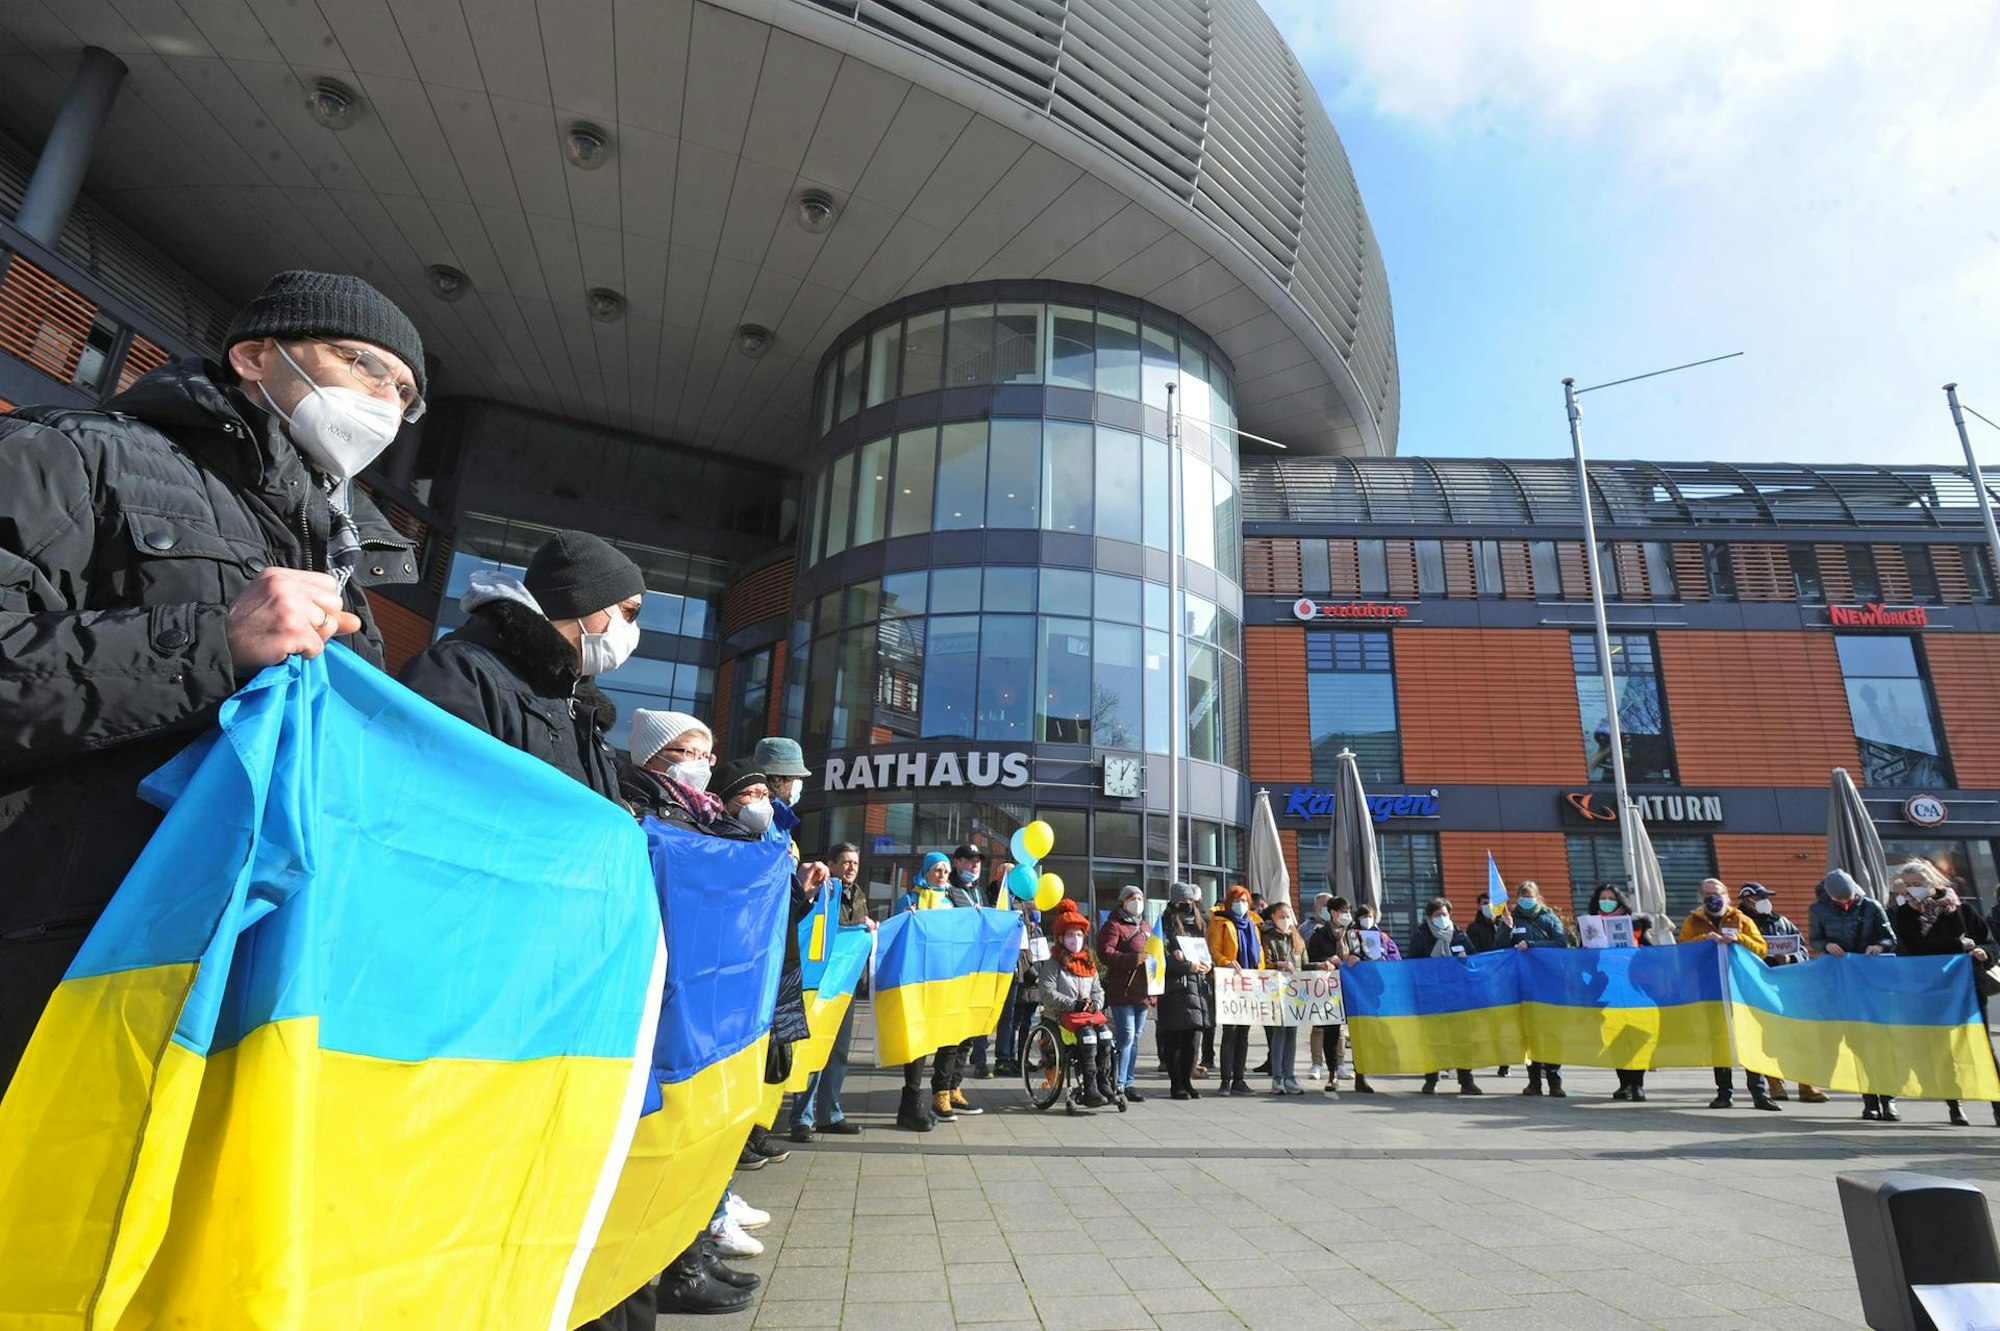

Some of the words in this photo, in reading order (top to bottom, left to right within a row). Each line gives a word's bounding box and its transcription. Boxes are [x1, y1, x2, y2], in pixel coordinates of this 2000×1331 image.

[1322, 601, 1407, 617] vodafone
[824, 752, 1029, 791] RATHAUS
[1624, 795, 1723, 821] ATURN
[1914, 803, 1941, 817] C&A
[1775, 941, 1793, 950] WAR
[1223, 975, 1270, 994] НЕТ
[1287, 976, 1339, 998] STOP
[1289, 999, 1345, 1022] WAR!
